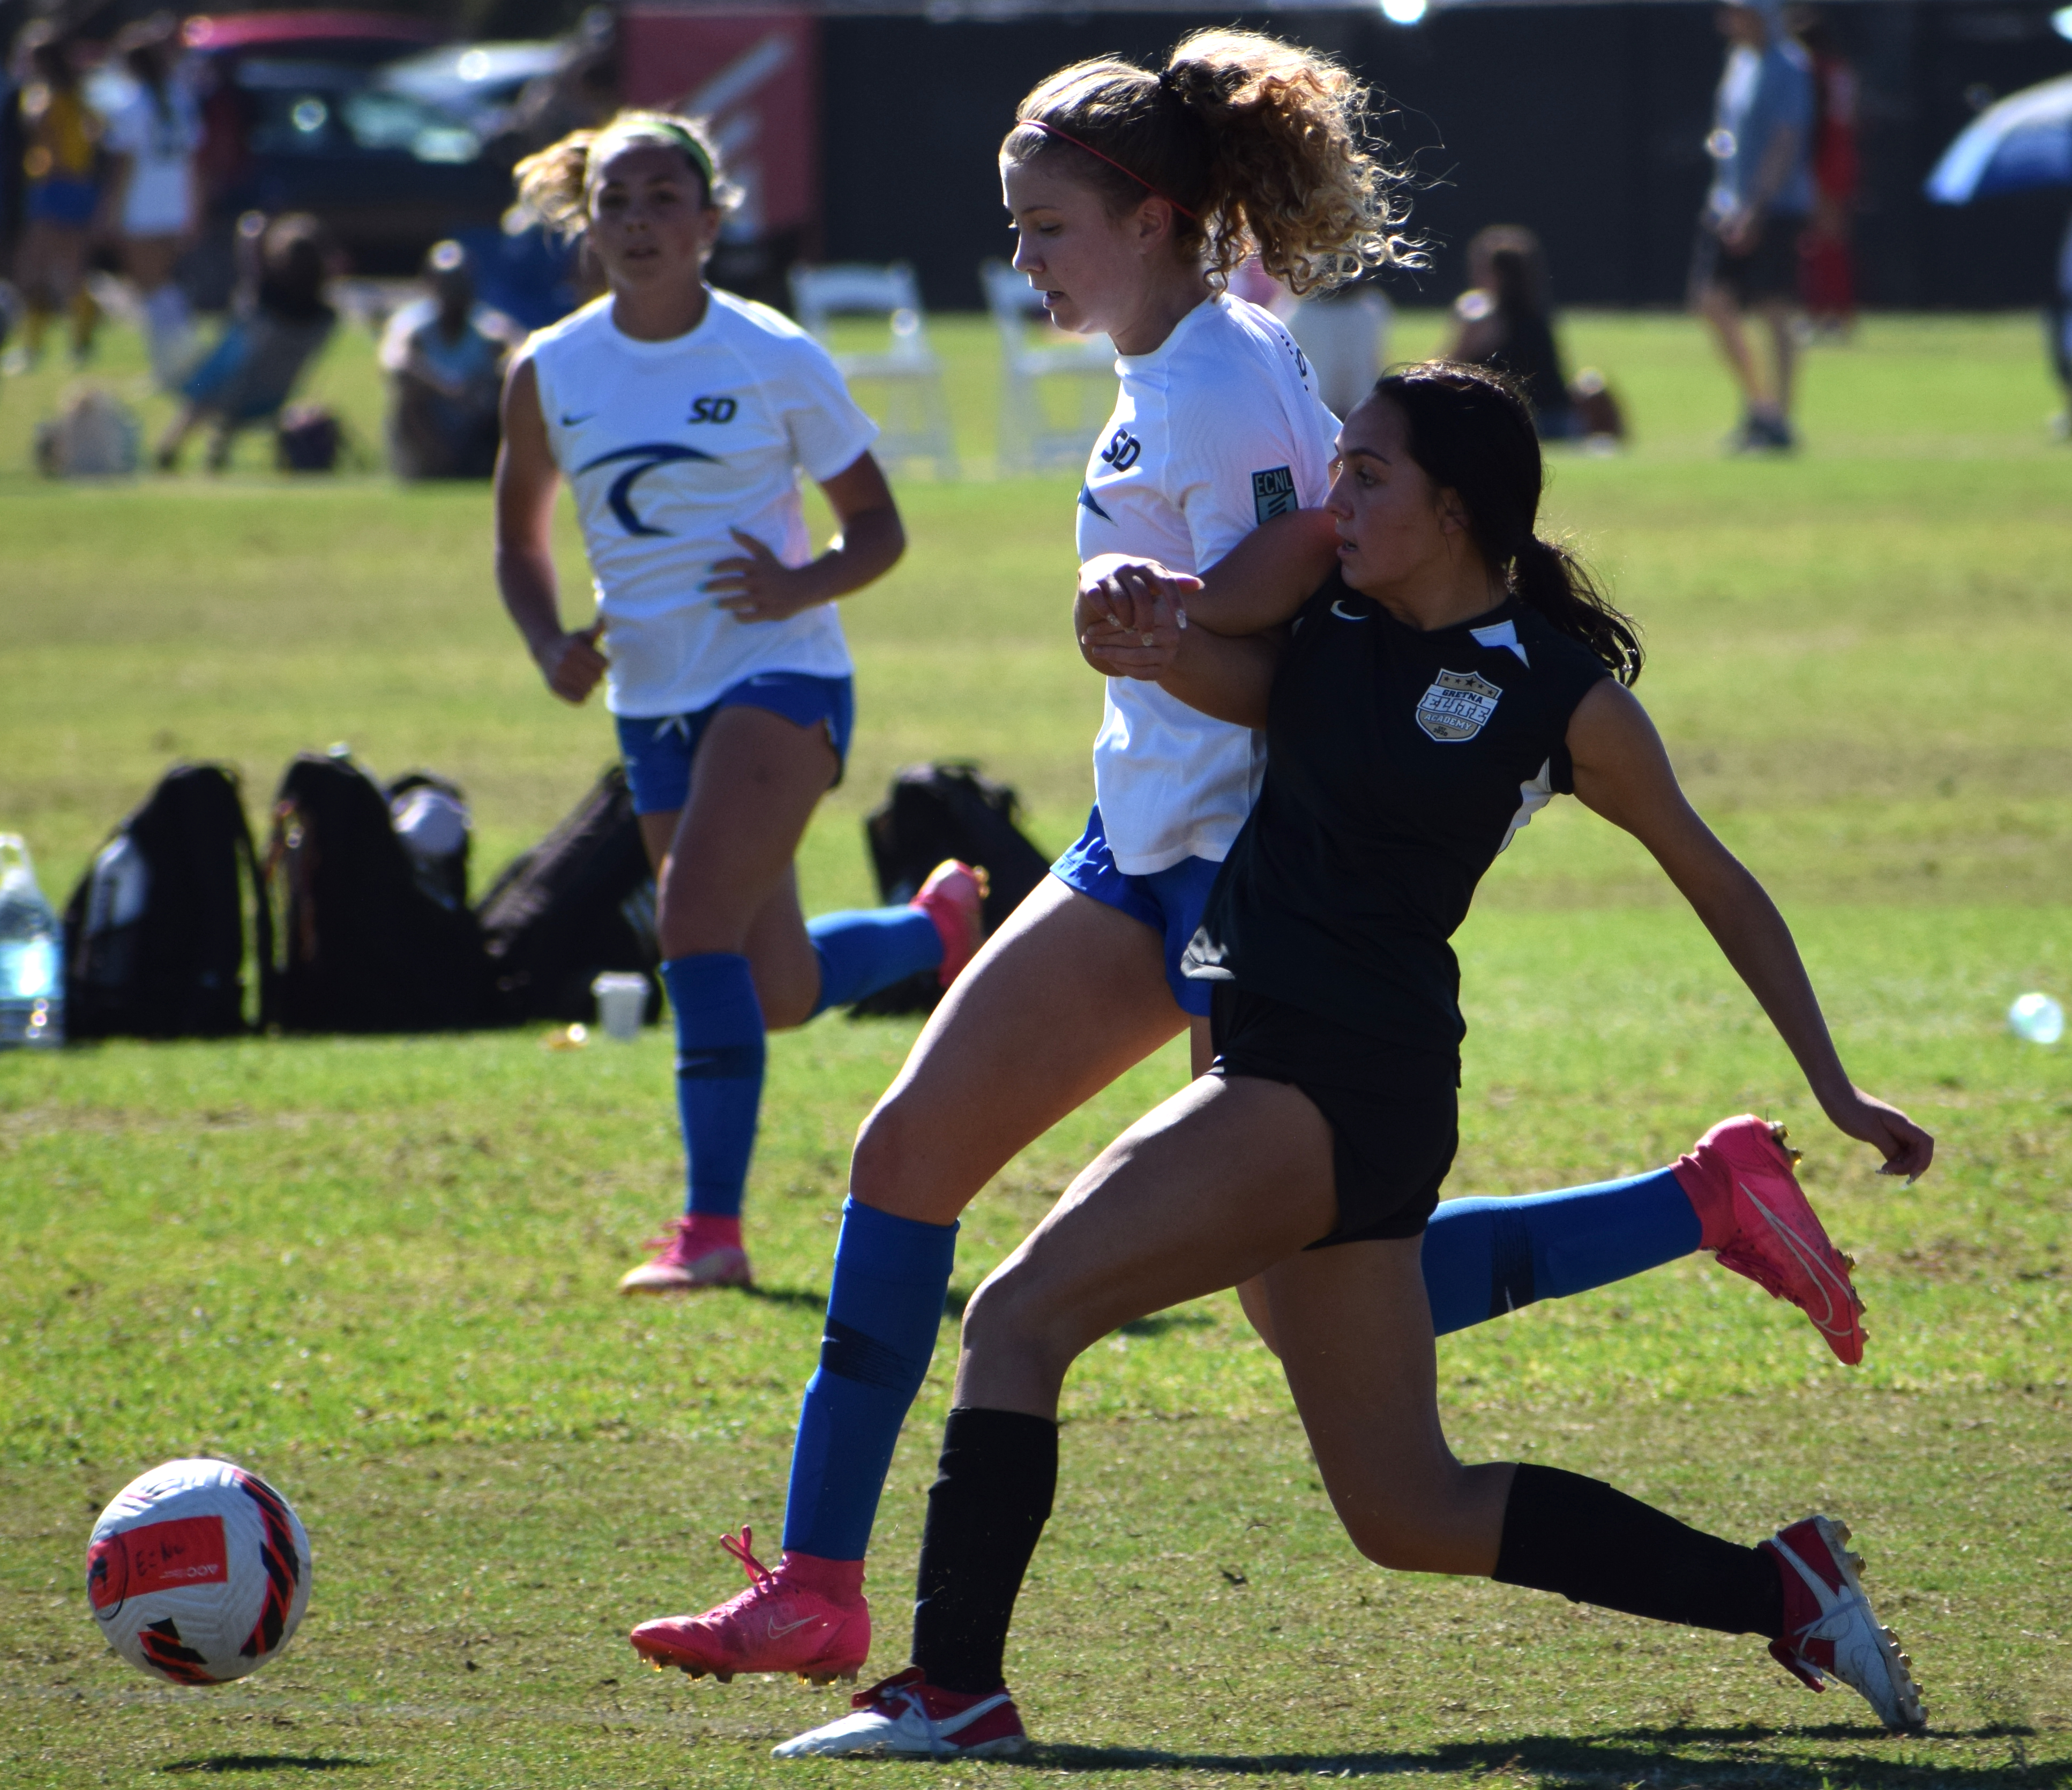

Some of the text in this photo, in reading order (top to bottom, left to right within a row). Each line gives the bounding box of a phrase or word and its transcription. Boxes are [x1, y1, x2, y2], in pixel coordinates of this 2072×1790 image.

[687, 398, 737, 424] SD
[1101, 428, 1141, 472] SD
[1255, 470, 1293, 496] ECNL
[1420, 693, 1491, 724] ELITE
[1442, 689, 1483, 704] GRETNA
[1424, 714, 1472, 730] ACADEMY
